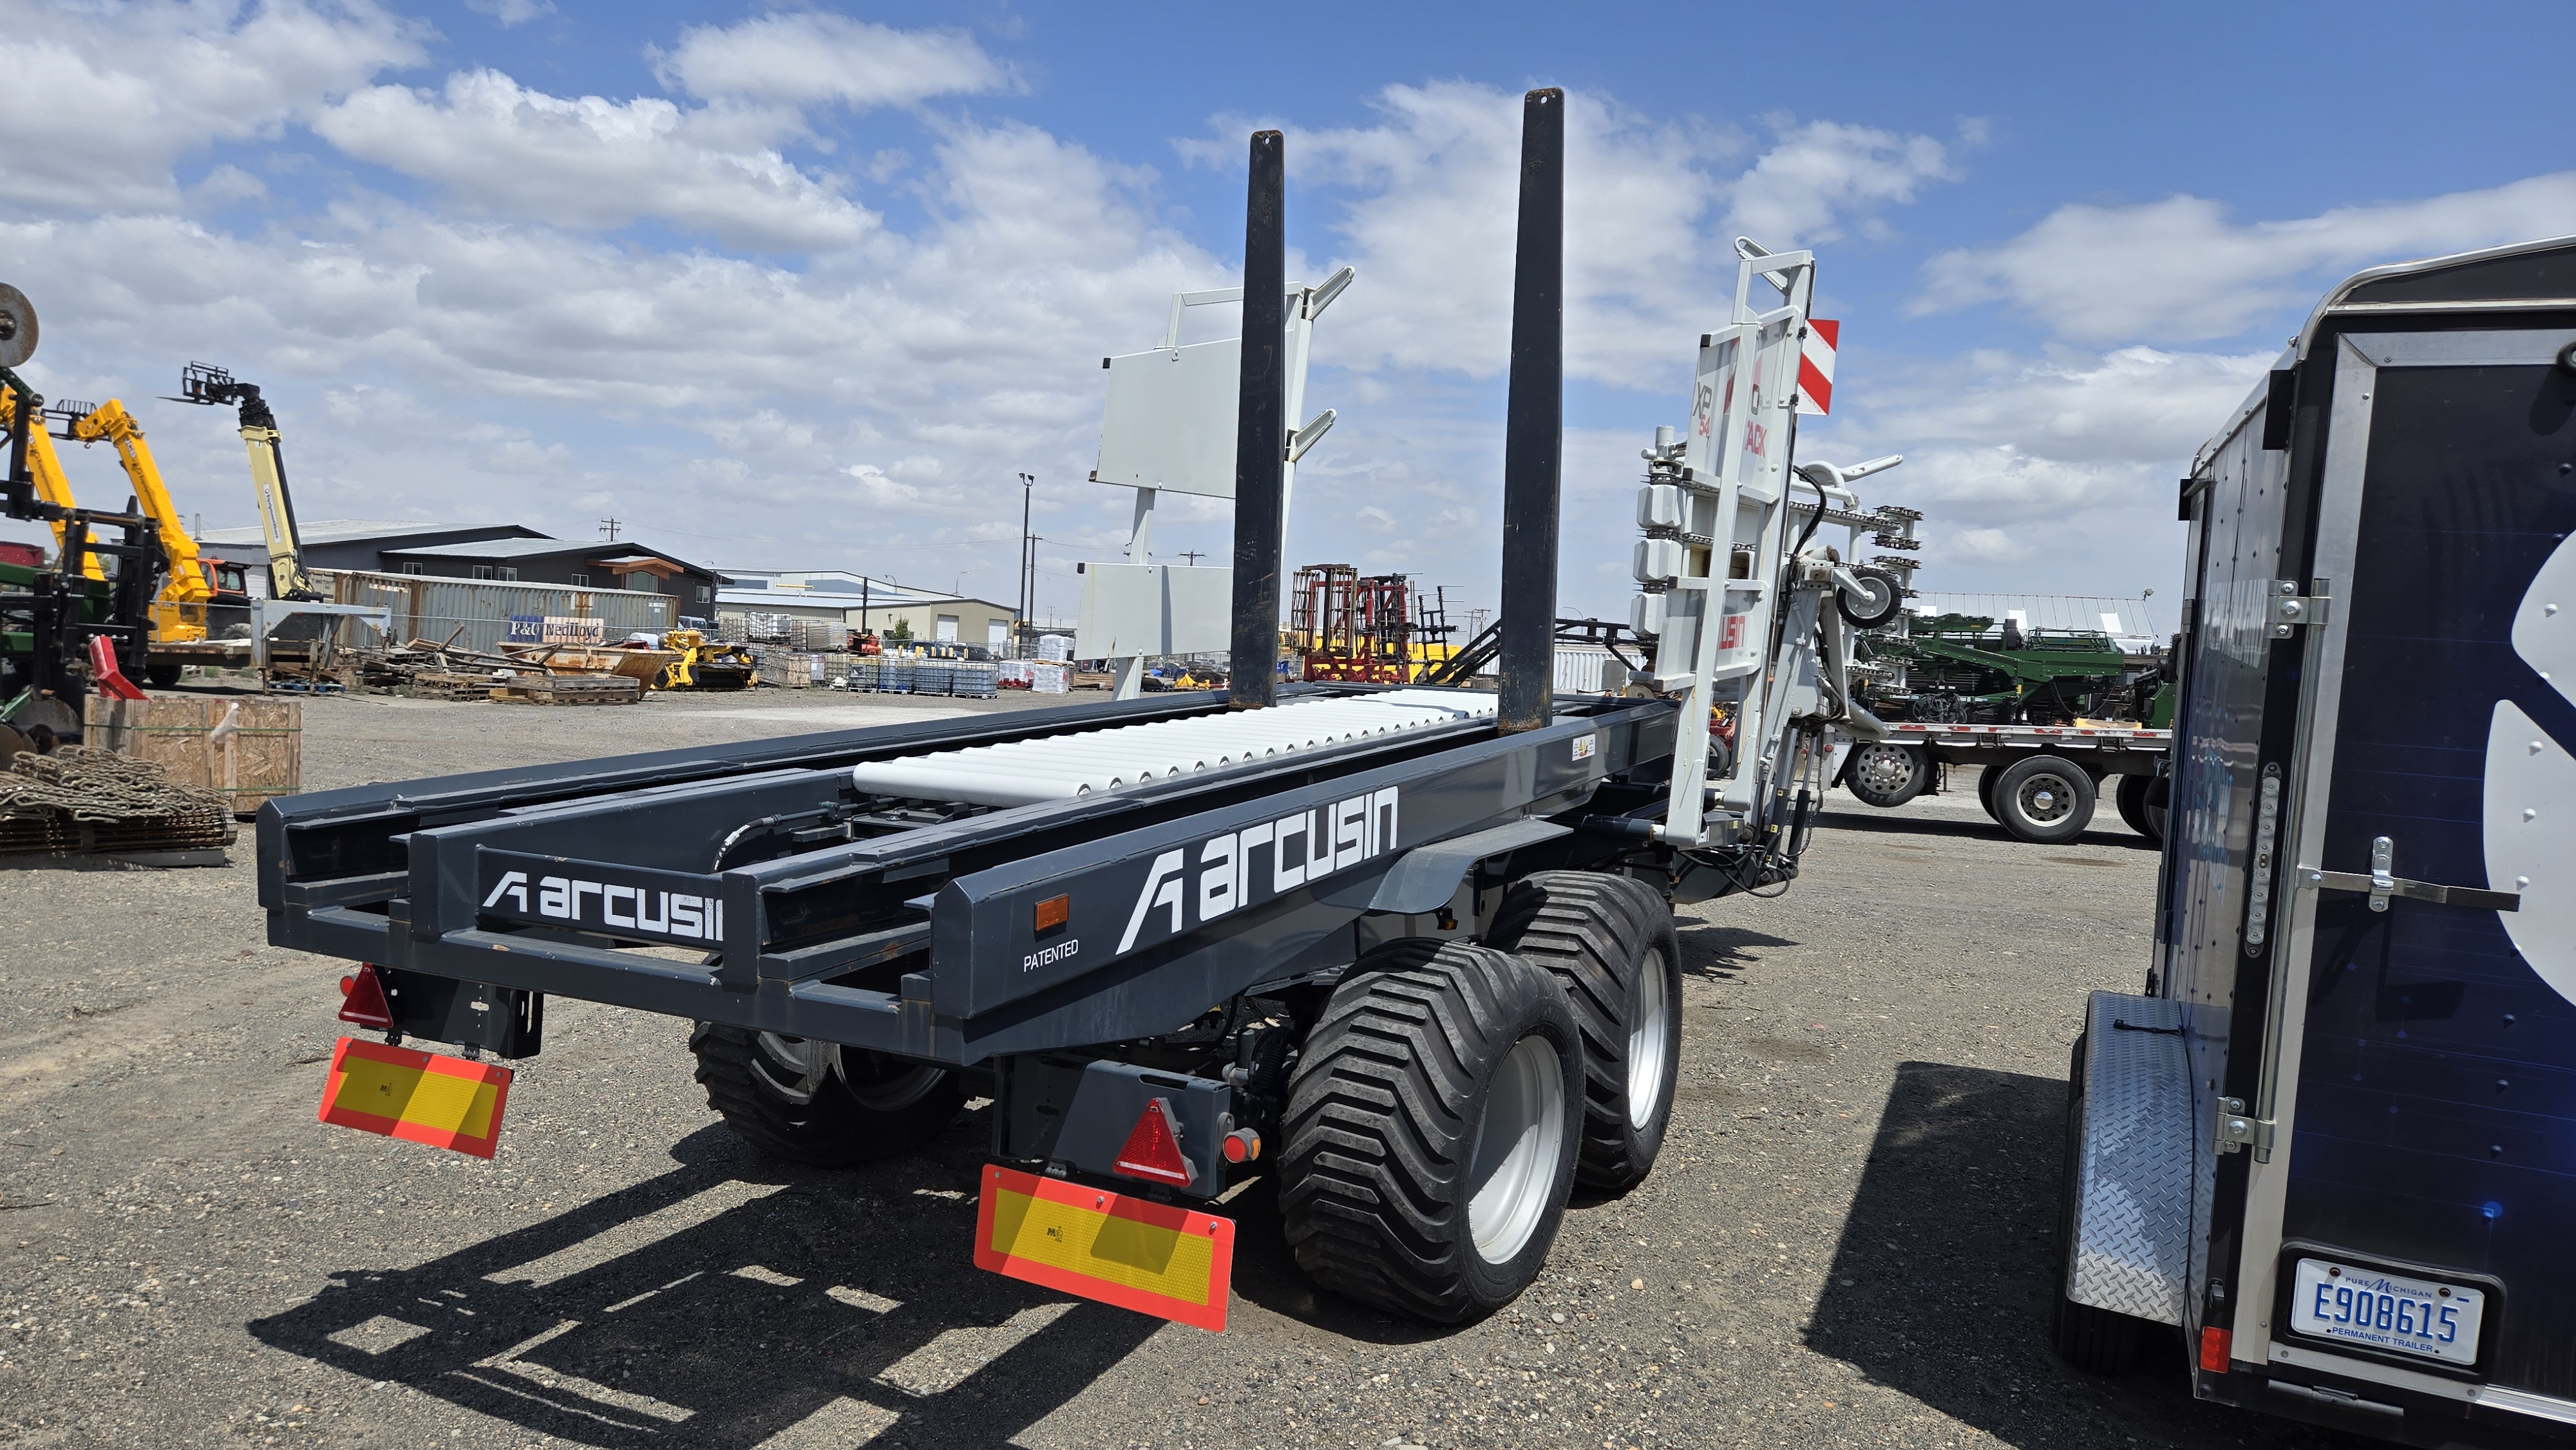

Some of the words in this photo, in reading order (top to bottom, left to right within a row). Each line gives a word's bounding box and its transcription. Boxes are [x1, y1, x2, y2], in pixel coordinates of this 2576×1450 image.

[125, 438, 137, 459] JCB
[510, 621, 540, 636] P&O
[545, 622, 600, 641] Nedlloyd
[1023, 939, 1079, 972] PATENTED
[2345, 1277, 2370, 1286] PURE
[2315, 1283, 2458, 1343] E908615
[2332, 1326, 2391, 1344] PERMANENT
[2392, 1337, 2433, 1352] TRAILER
